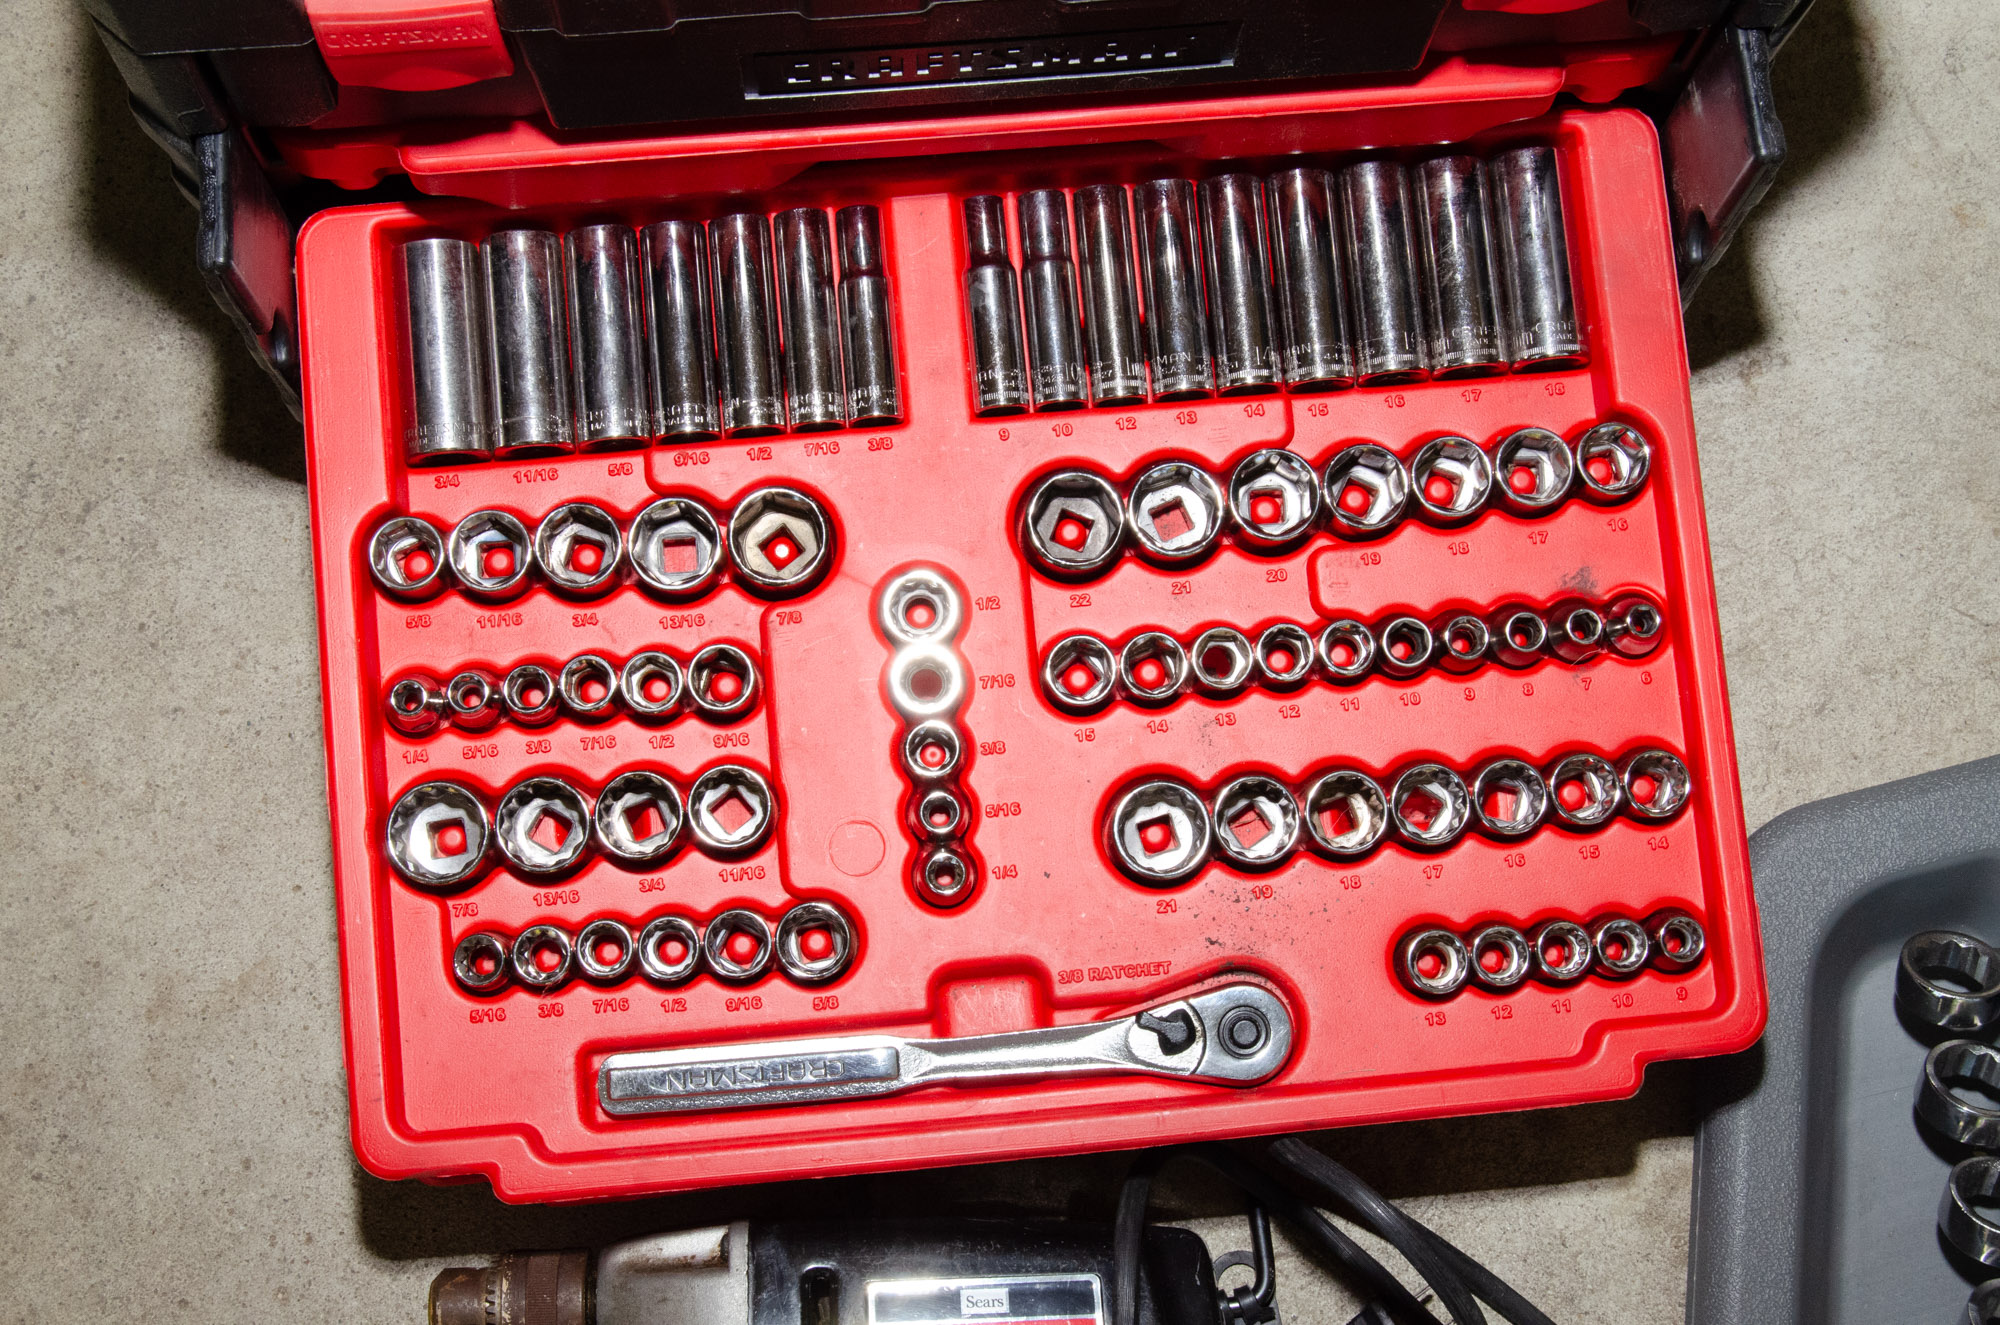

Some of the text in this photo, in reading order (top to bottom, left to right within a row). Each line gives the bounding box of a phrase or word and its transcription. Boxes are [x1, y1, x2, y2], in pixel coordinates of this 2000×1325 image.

[324, 25, 489, 48] CRAFTSMAN
[1461, 388, 1482, 403] 17
[1545, 382, 1565, 396] 18
[1384, 394, 1407, 408] 16
[1243, 403, 1266, 417] 14
[1307, 402, 1328, 416] 15
[1115, 416, 1136, 430] 12
[1176, 410, 1198, 424] 13
[999, 428, 1009, 441] 9
[1052, 423, 1073, 437] 10
[803, 441, 840, 456] 7/16
[866, 436, 893, 451] 3/8
[672, 451, 710, 467] 9/16
[745, 446, 772, 461] 1/2
[511, 467, 558, 483] 11/16
[606, 461, 633, 476] 5/8
[434, 474, 460, 489] 3/4
[1607, 518, 1628, 532] 16
[1528, 531, 1548, 544] 17
[1448, 542, 1469, 555] 18
[1359, 550, 1381, 566] 19
[1266, 568, 1287, 583] 20
[1171, 580, 1191, 595] 21
[976, 596, 1000, 610] 1/2
[1069, 593, 1091, 608] 22
[405, 612, 431, 629] 5/8
[477, 612, 523, 629] 11/16
[572, 613, 599, 627] 3/4
[659, 611, 705, 629] 13/16
[776, 609, 802, 626] 7/8
[979, 673, 1015, 689] 7/16
[1581, 677, 1592, 691] 7
[1641, 671, 1652, 685] 6
[1464, 688, 1475, 701] 9
[1523, 683, 1534, 696] 8
[1340, 696, 1359, 712] 11
[1400, 692, 1421, 706] 10
[1215, 712, 1236, 727] 13
[1278, 705, 1300, 719] 12
[1146, 720, 1168, 734] 14
[648, 733, 674, 749] 1/2
[713, 730, 750, 748] 9/16
[1074, 728, 1095, 742] 15
[525, 738, 551, 754] 3/8
[580, 735, 616, 751] 7/16
[980, 741, 1006, 756] 3/8
[402, 747, 429, 764] 1/4
[463, 743, 499, 759] 5/16
[985, 802, 1021, 818] 5/16
[1648, 836, 1669, 851] 14
[1503, 852, 1526, 868] 16
[1579, 845, 1600, 860] 15
[719, 865, 766, 882] 11/16
[992, 864, 1018, 879] 1/4
[1422, 863, 1443, 880] 17
[638, 877, 665, 893] 3/4
[1340, 875, 1361, 890] 18
[533, 889, 580, 907] 13/16
[1252, 885, 1273, 899] 19
[452, 902, 478, 918] 7/8
[1155, 897, 1176, 914] 21
[1058, 961, 1171, 984] 3/8 RATCHET
[1611, 993, 1633, 1008] 10
[1676, 987, 1688, 1001] 9
[538, 1003, 564, 1018] 3/8
[593, 998, 629, 1014] 7/16
[661, 998, 687, 1013] 1/2
[725, 996, 762, 1012] 9/16
[812, 995, 839, 1011] 5/8
[1552, 999, 1571, 1014] 11
[470, 1008, 506, 1024] 5/16
[1425, 1012, 1446, 1027] 13
[1491, 1005, 1512, 1020] 12
[666, 1059, 846, 1091] CRAFTSMAN
[966, 1295, 1004, 1309] Sears
